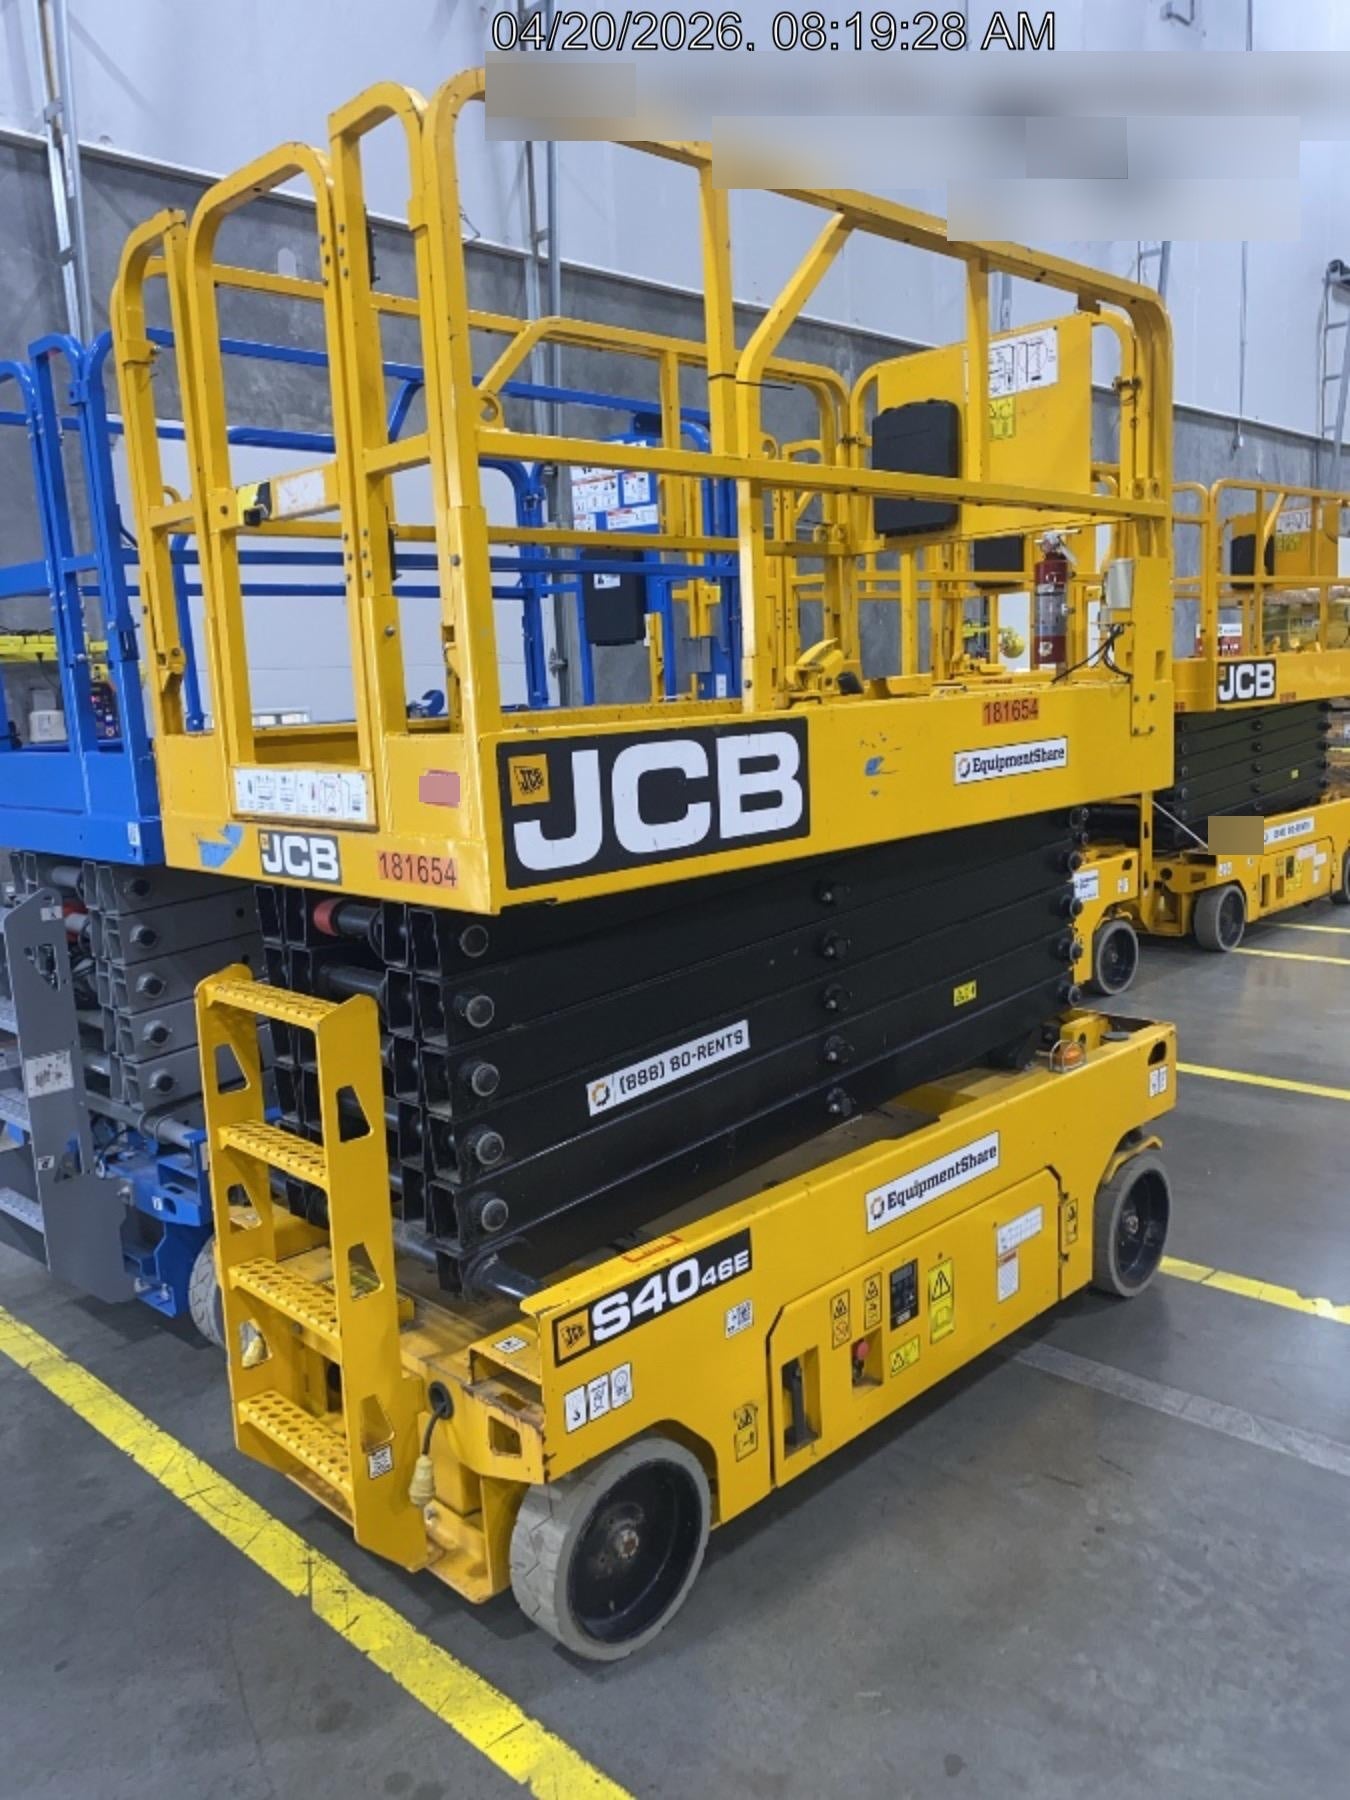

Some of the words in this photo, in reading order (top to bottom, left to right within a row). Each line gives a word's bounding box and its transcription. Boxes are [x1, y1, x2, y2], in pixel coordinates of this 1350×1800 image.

[1218, 662, 1275, 702] JCB
[983, 697, 1039, 725] 181654
[972, 747, 1065, 775] EquipmentShare
[513, 731, 803, 870] JCB
[262, 833, 340, 881] JCB
[379, 852, 457, 887] 181654
[619, 1060, 665, 1095] (888)
[669, 1029, 743, 1073] 80-RENTS
[887, 1145, 997, 1211] EquipmentShare
